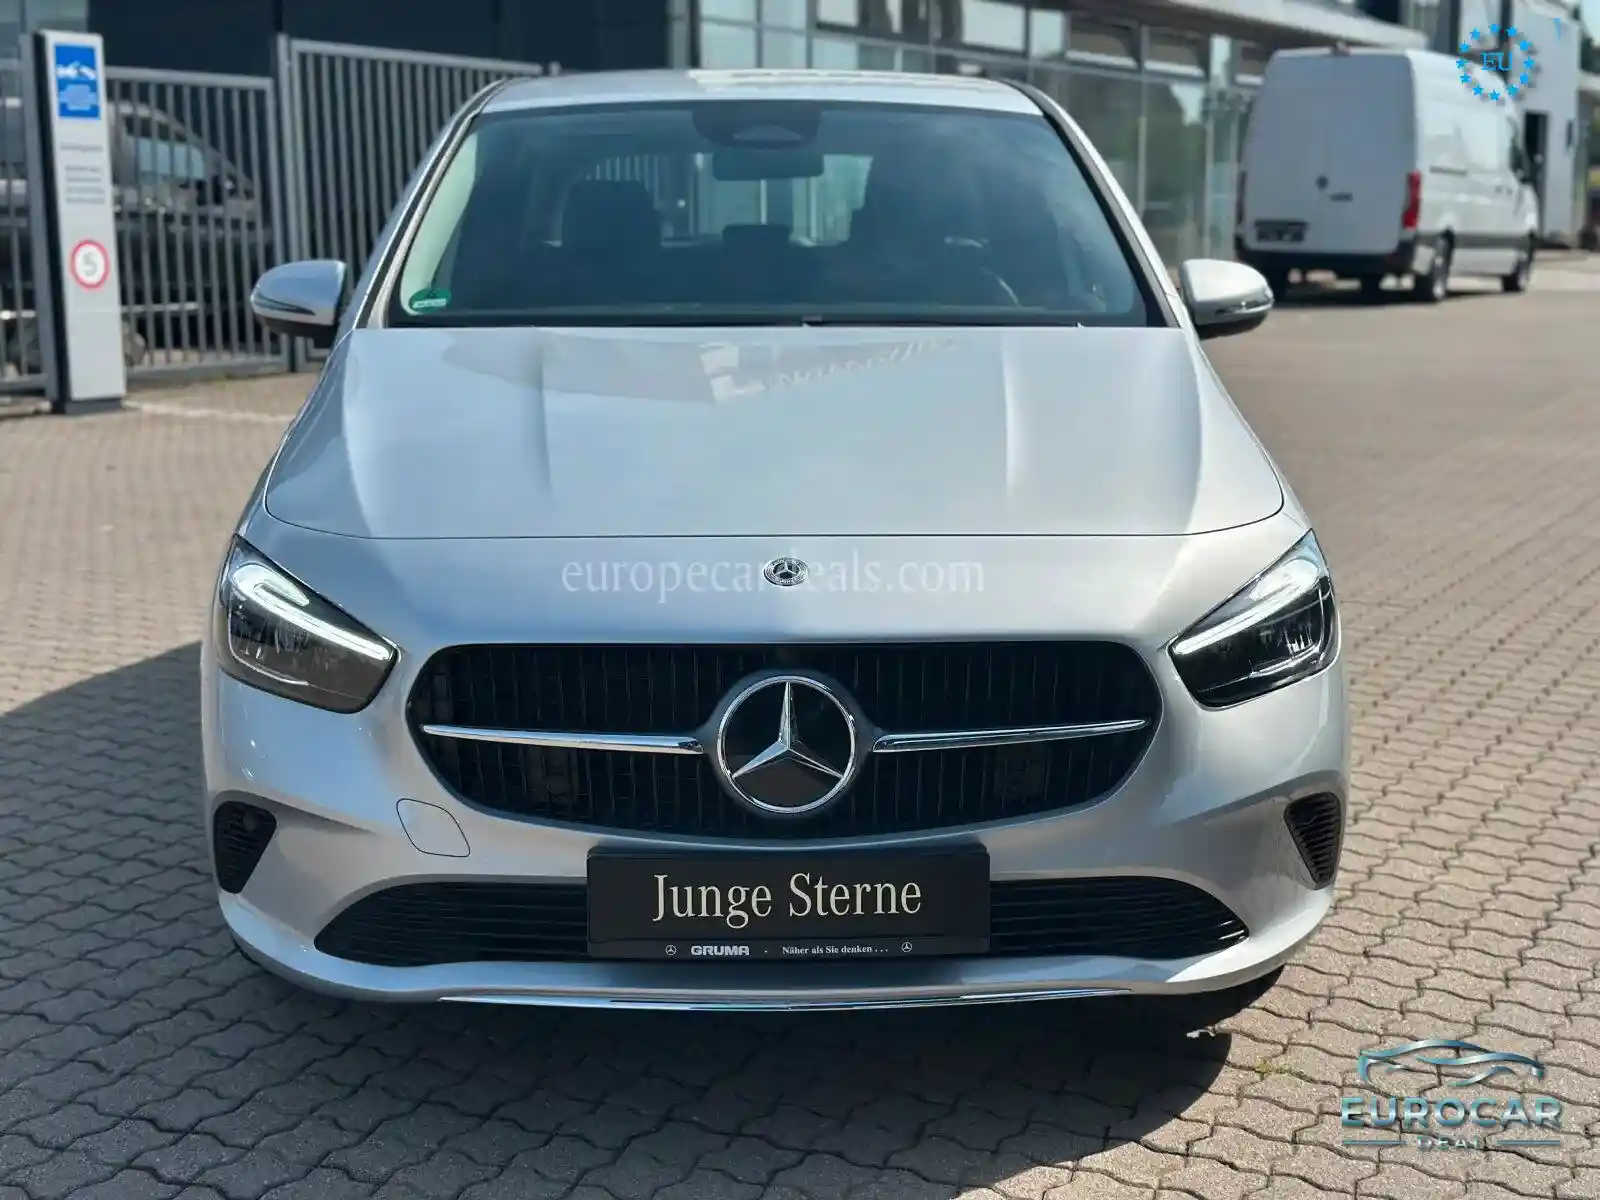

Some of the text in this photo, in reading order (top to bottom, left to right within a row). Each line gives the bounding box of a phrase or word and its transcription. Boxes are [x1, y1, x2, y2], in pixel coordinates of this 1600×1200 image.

[83, 251, 98, 277] 5
[652, 872, 922, 929] Junge Sterne
[690, 945, 750, 956] GRUMA
[782, 945, 809, 955] Näher
[811, 945, 824, 954] als
[825, 945, 839, 954] Sie
[841, 944, 872, 954] denken
